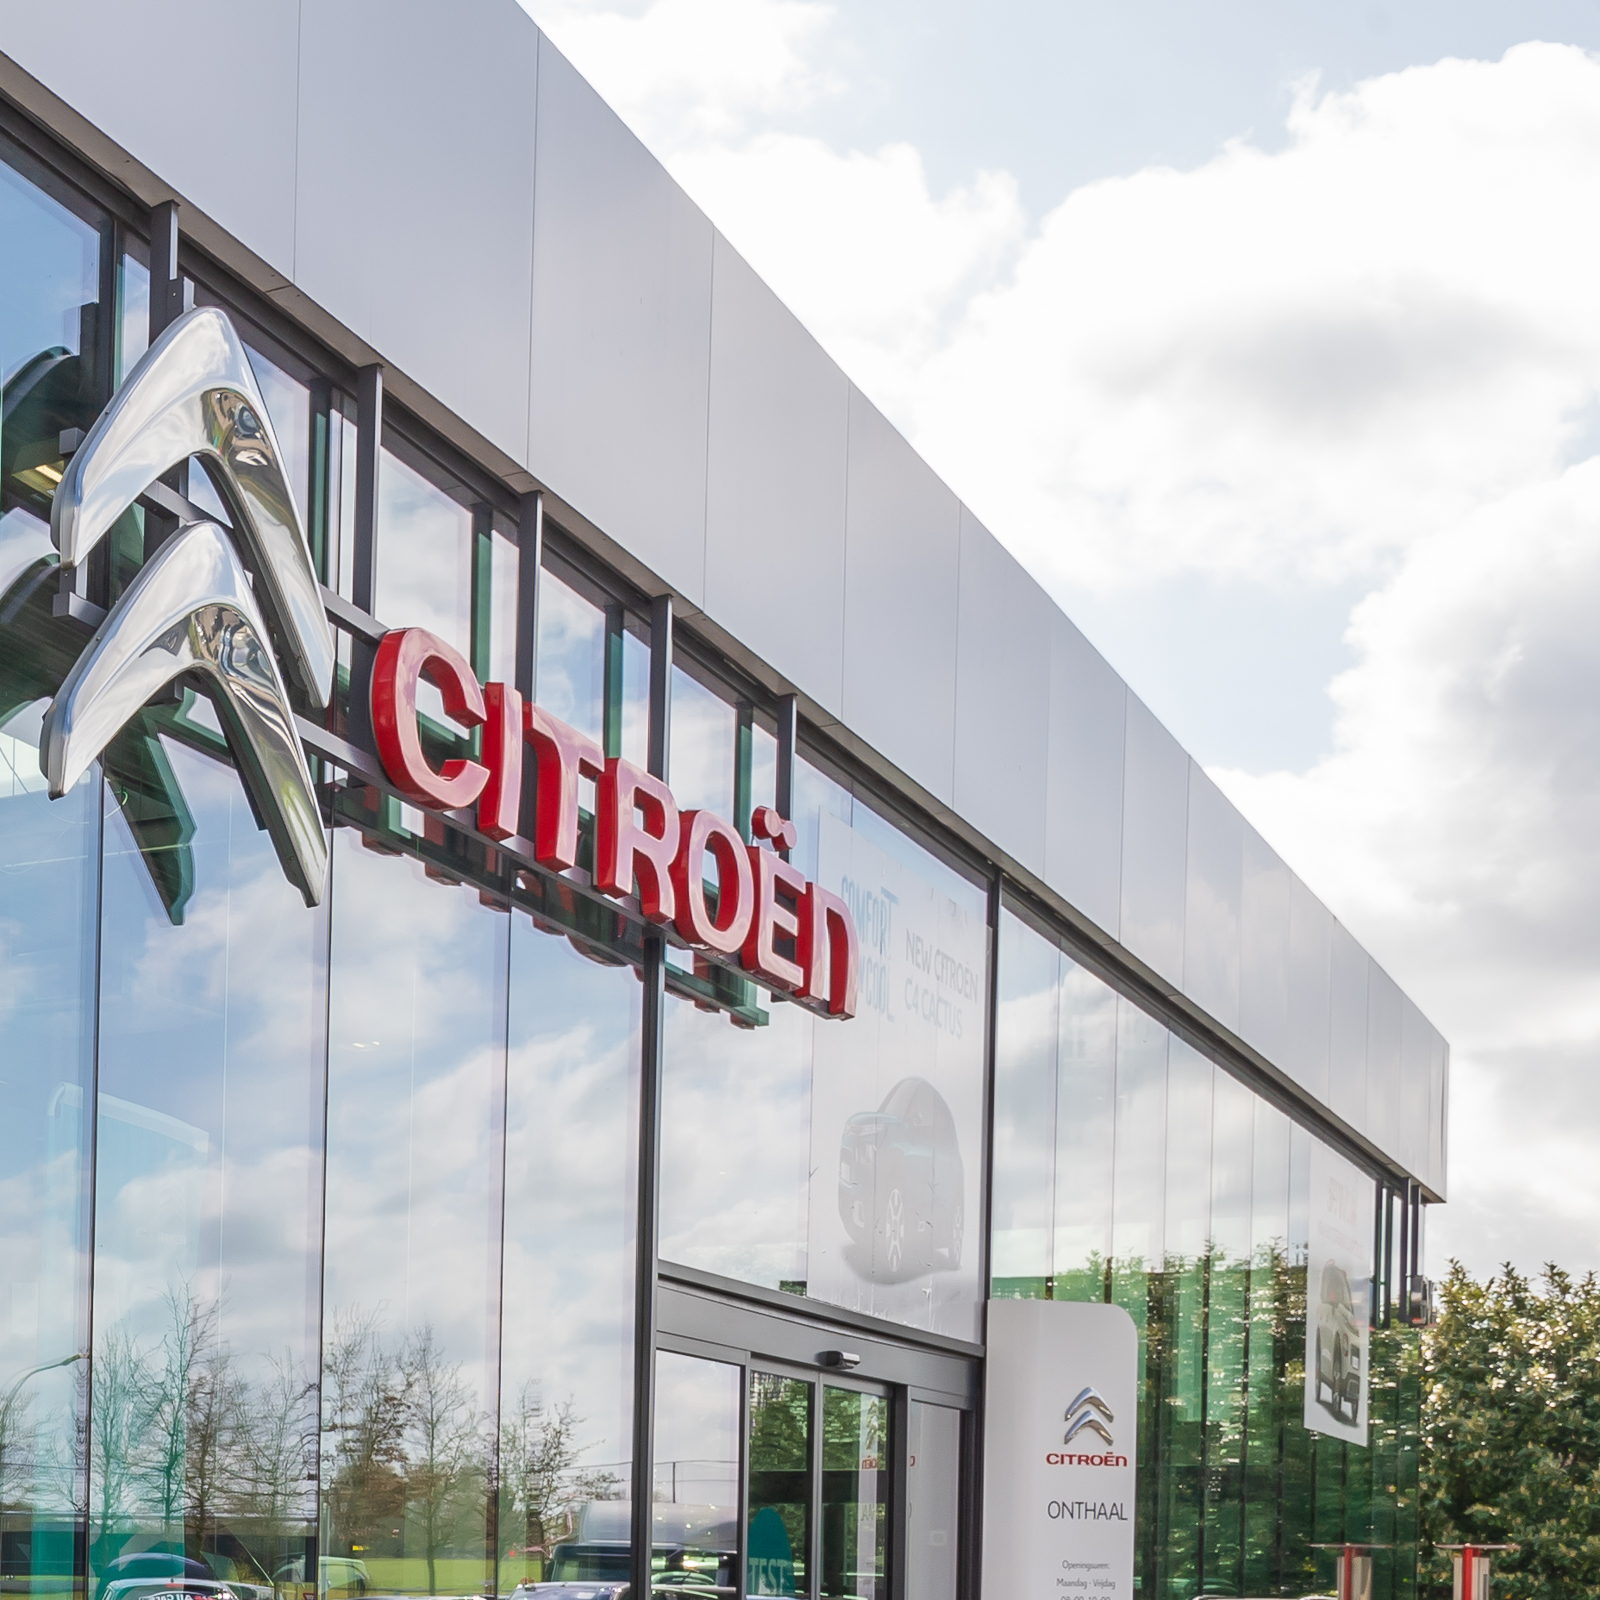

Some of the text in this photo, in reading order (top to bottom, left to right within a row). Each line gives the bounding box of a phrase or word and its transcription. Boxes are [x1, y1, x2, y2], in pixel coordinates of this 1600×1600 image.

[371, 626, 859, 1020] CITROËN
[906, 928, 978, 1003] NEW CITROËN
[904, 977, 962, 1040] C4 CACTUS
[1046, 1451, 1128, 1467] CITROËN
[1047, 1501, 1128, 1521] ONTHAAL
[749, 1557, 788, 1595] TEST
[1056, 1578, 1087, 1590] Maandag
[1092, 1578, 1116, 1590] Vrijdag
